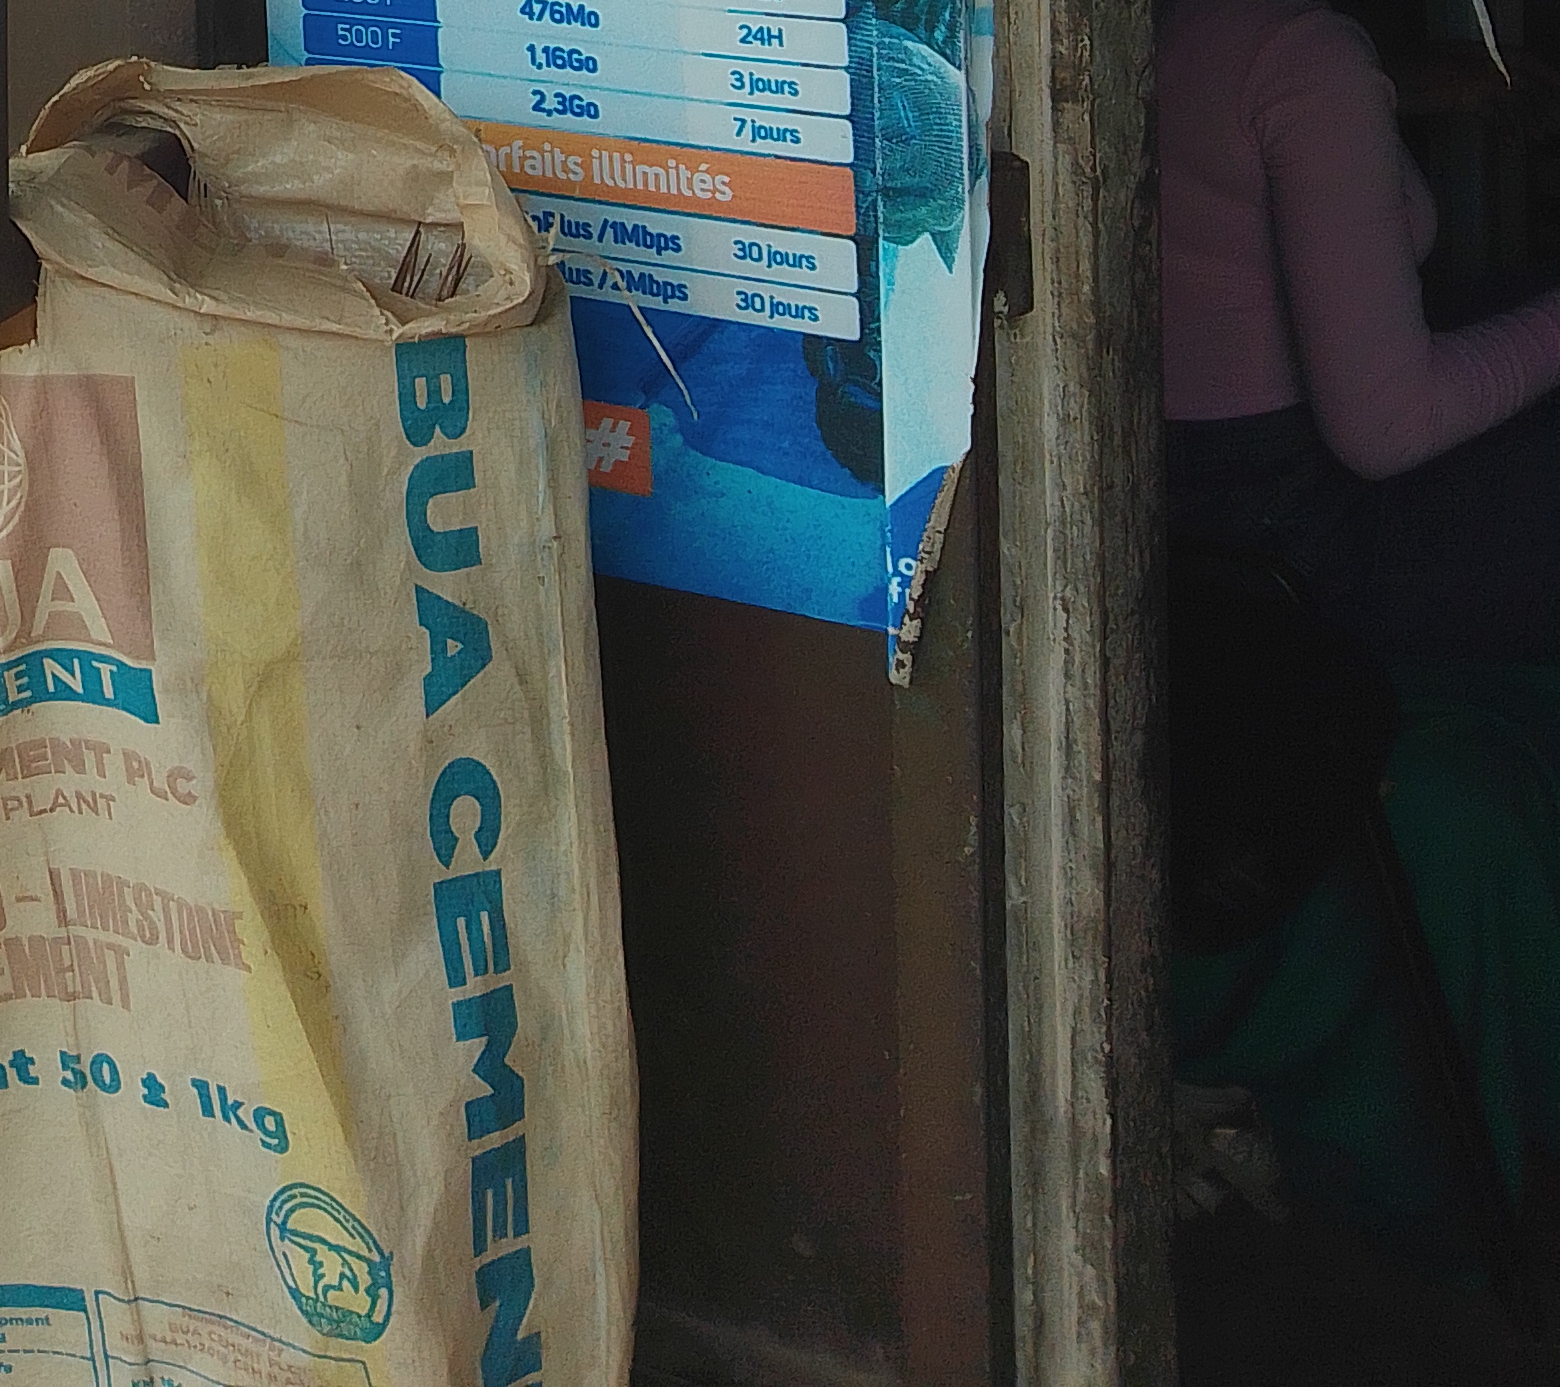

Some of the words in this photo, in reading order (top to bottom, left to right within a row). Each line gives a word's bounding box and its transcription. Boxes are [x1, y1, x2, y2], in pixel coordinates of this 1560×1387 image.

[336, 23, 382, 48] 500
[387, 28, 402, 50] F
[526, 43, 599, 74] 1,16Go
[729, 70, 744, 90] 3
[746, 73, 800, 98] jours
[737, 23, 786, 48] 24H
[530, 88, 600, 119] 2,3Go
[733, 116, 748, 137] 7
[749, 120, 802, 145] jours
[482, 139, 585, 182] orfaits
[590, 148, 734, 203] illimités
[597, 218, 683, 256] /1Mbps
[733, 239, 763, 263] 30
[765, 244, 818, 272] jours
[557, 260, 594, 287] lus
[735, 290, 765, 314] 30
[768, 295, 820, 323] jours
[394, 334, 494, 721] BUA
[0, 787, 116, 822] PLANT
[121, 747, 198, 806] PLC
[48, 866, 253, 974] LIMESTONE
[59, 1049, 122, 1095] 50
[189, 1076, 289, 1155] 1kg
